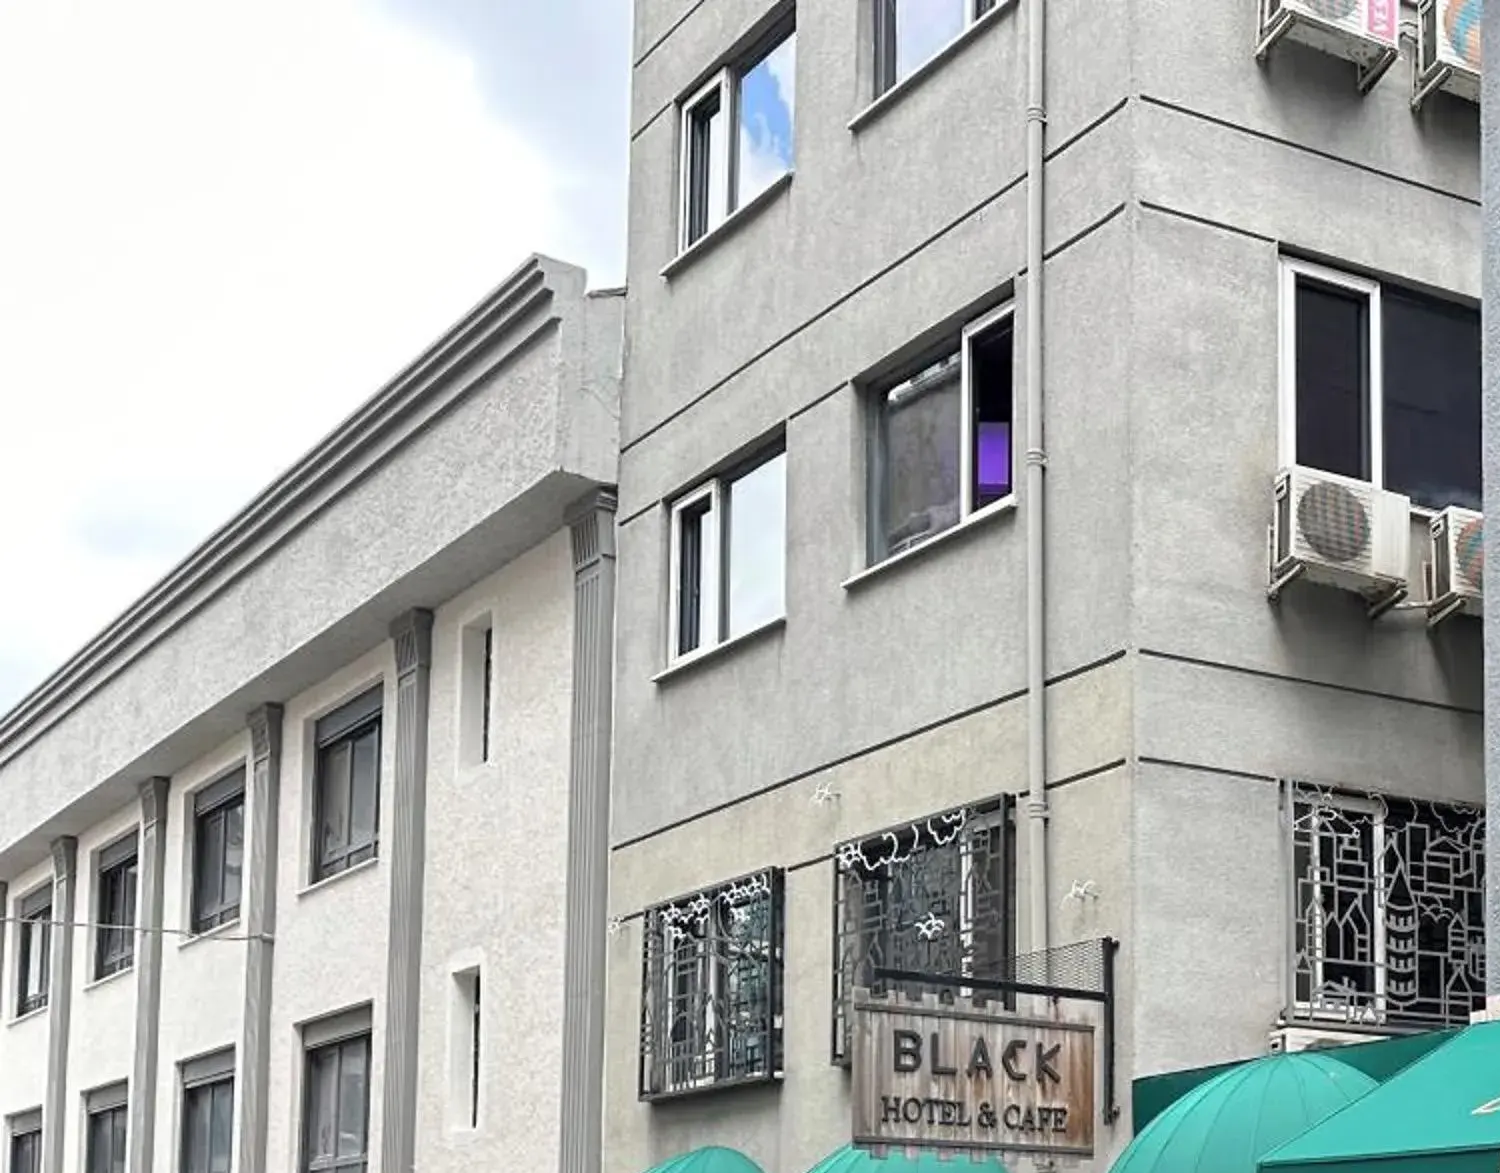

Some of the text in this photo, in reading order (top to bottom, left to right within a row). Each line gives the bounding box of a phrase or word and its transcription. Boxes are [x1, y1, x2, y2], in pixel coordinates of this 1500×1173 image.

[893, 1029, 1061, 1083] BLACK
[880, 1095, 1067, 1133] HOTEL & CAFE
